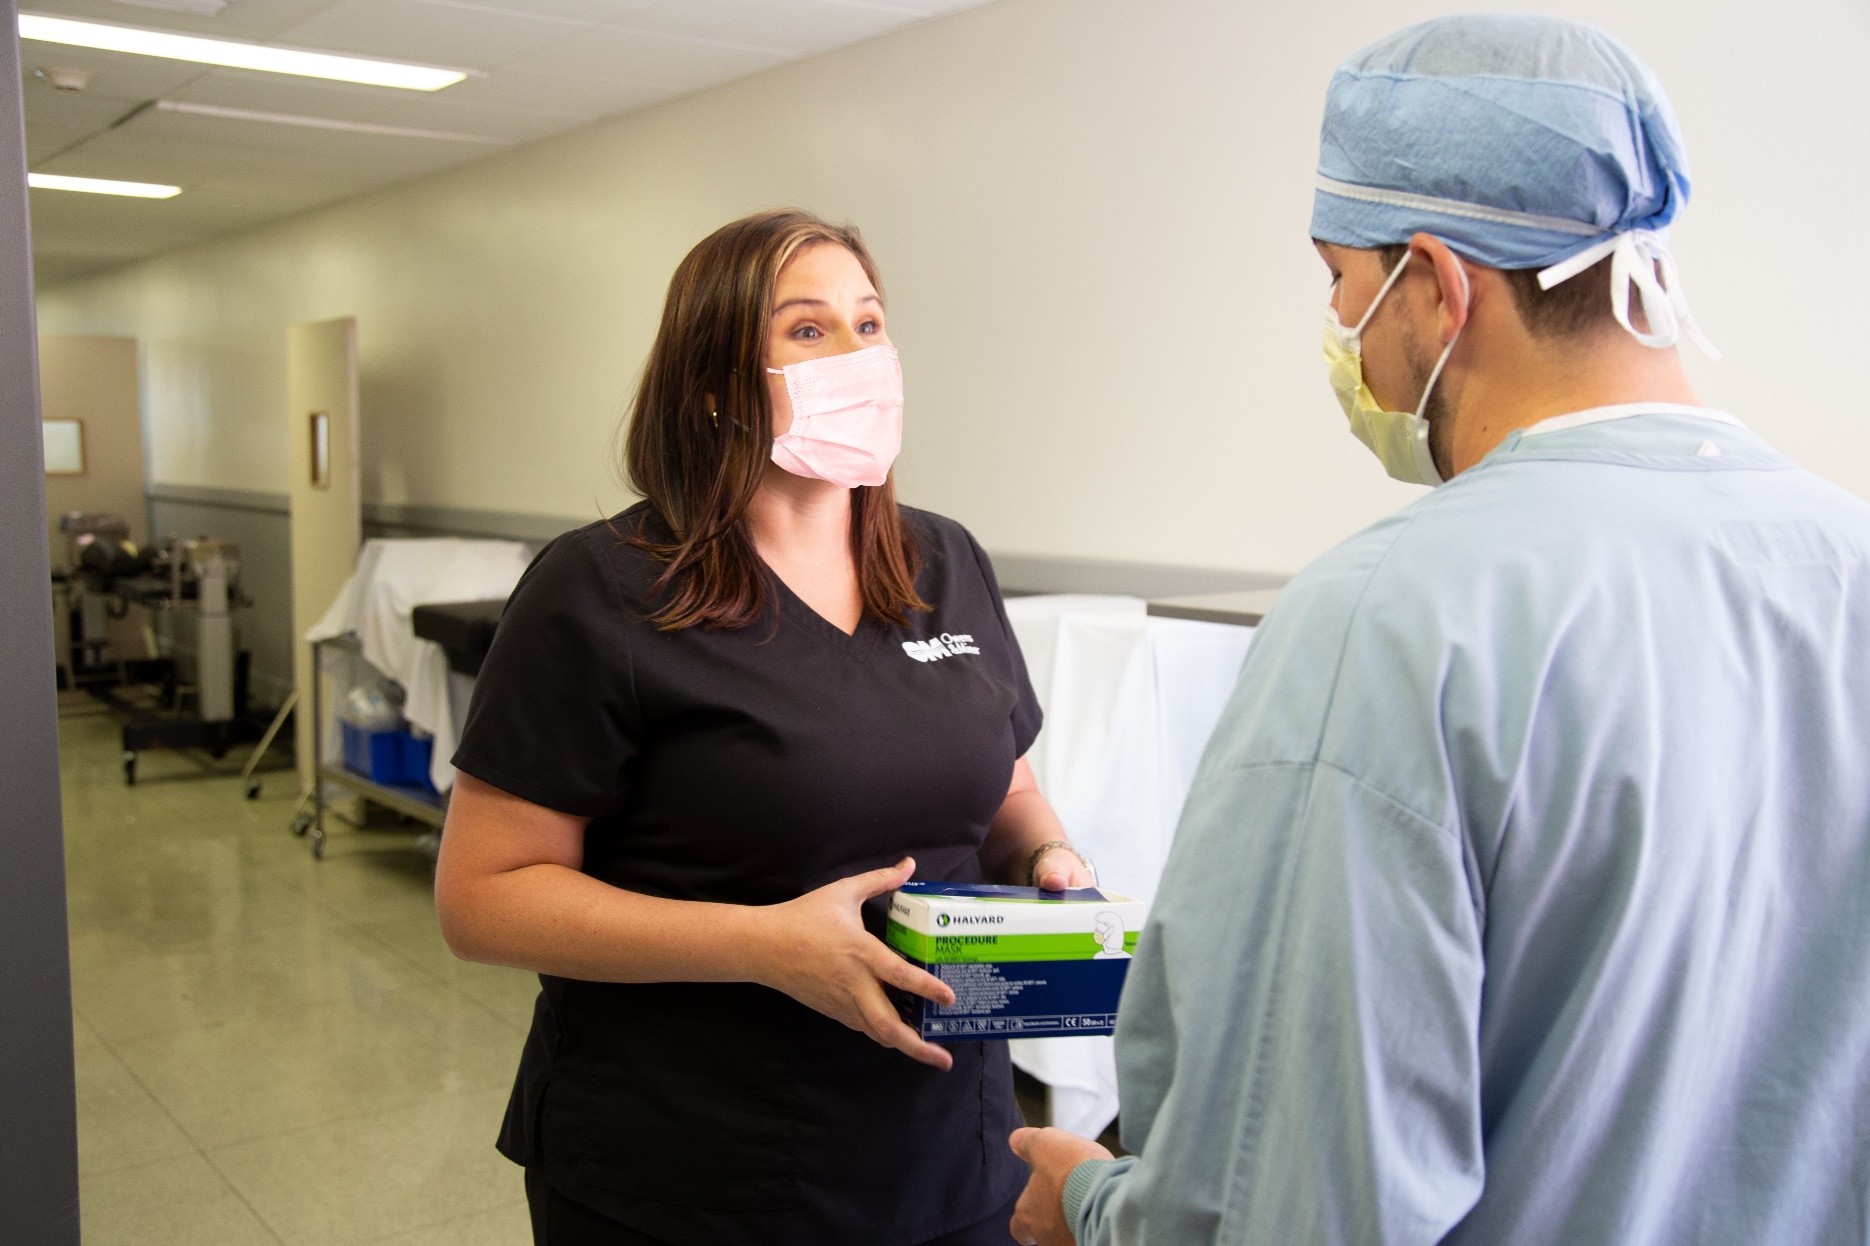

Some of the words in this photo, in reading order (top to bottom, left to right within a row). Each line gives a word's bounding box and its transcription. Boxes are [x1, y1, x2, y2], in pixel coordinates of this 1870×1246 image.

[953, 915, 1004, 925] HALYARD
[935, 935, 998, 946] PROCEDURE
[935, 945, 962, 955] MASK
